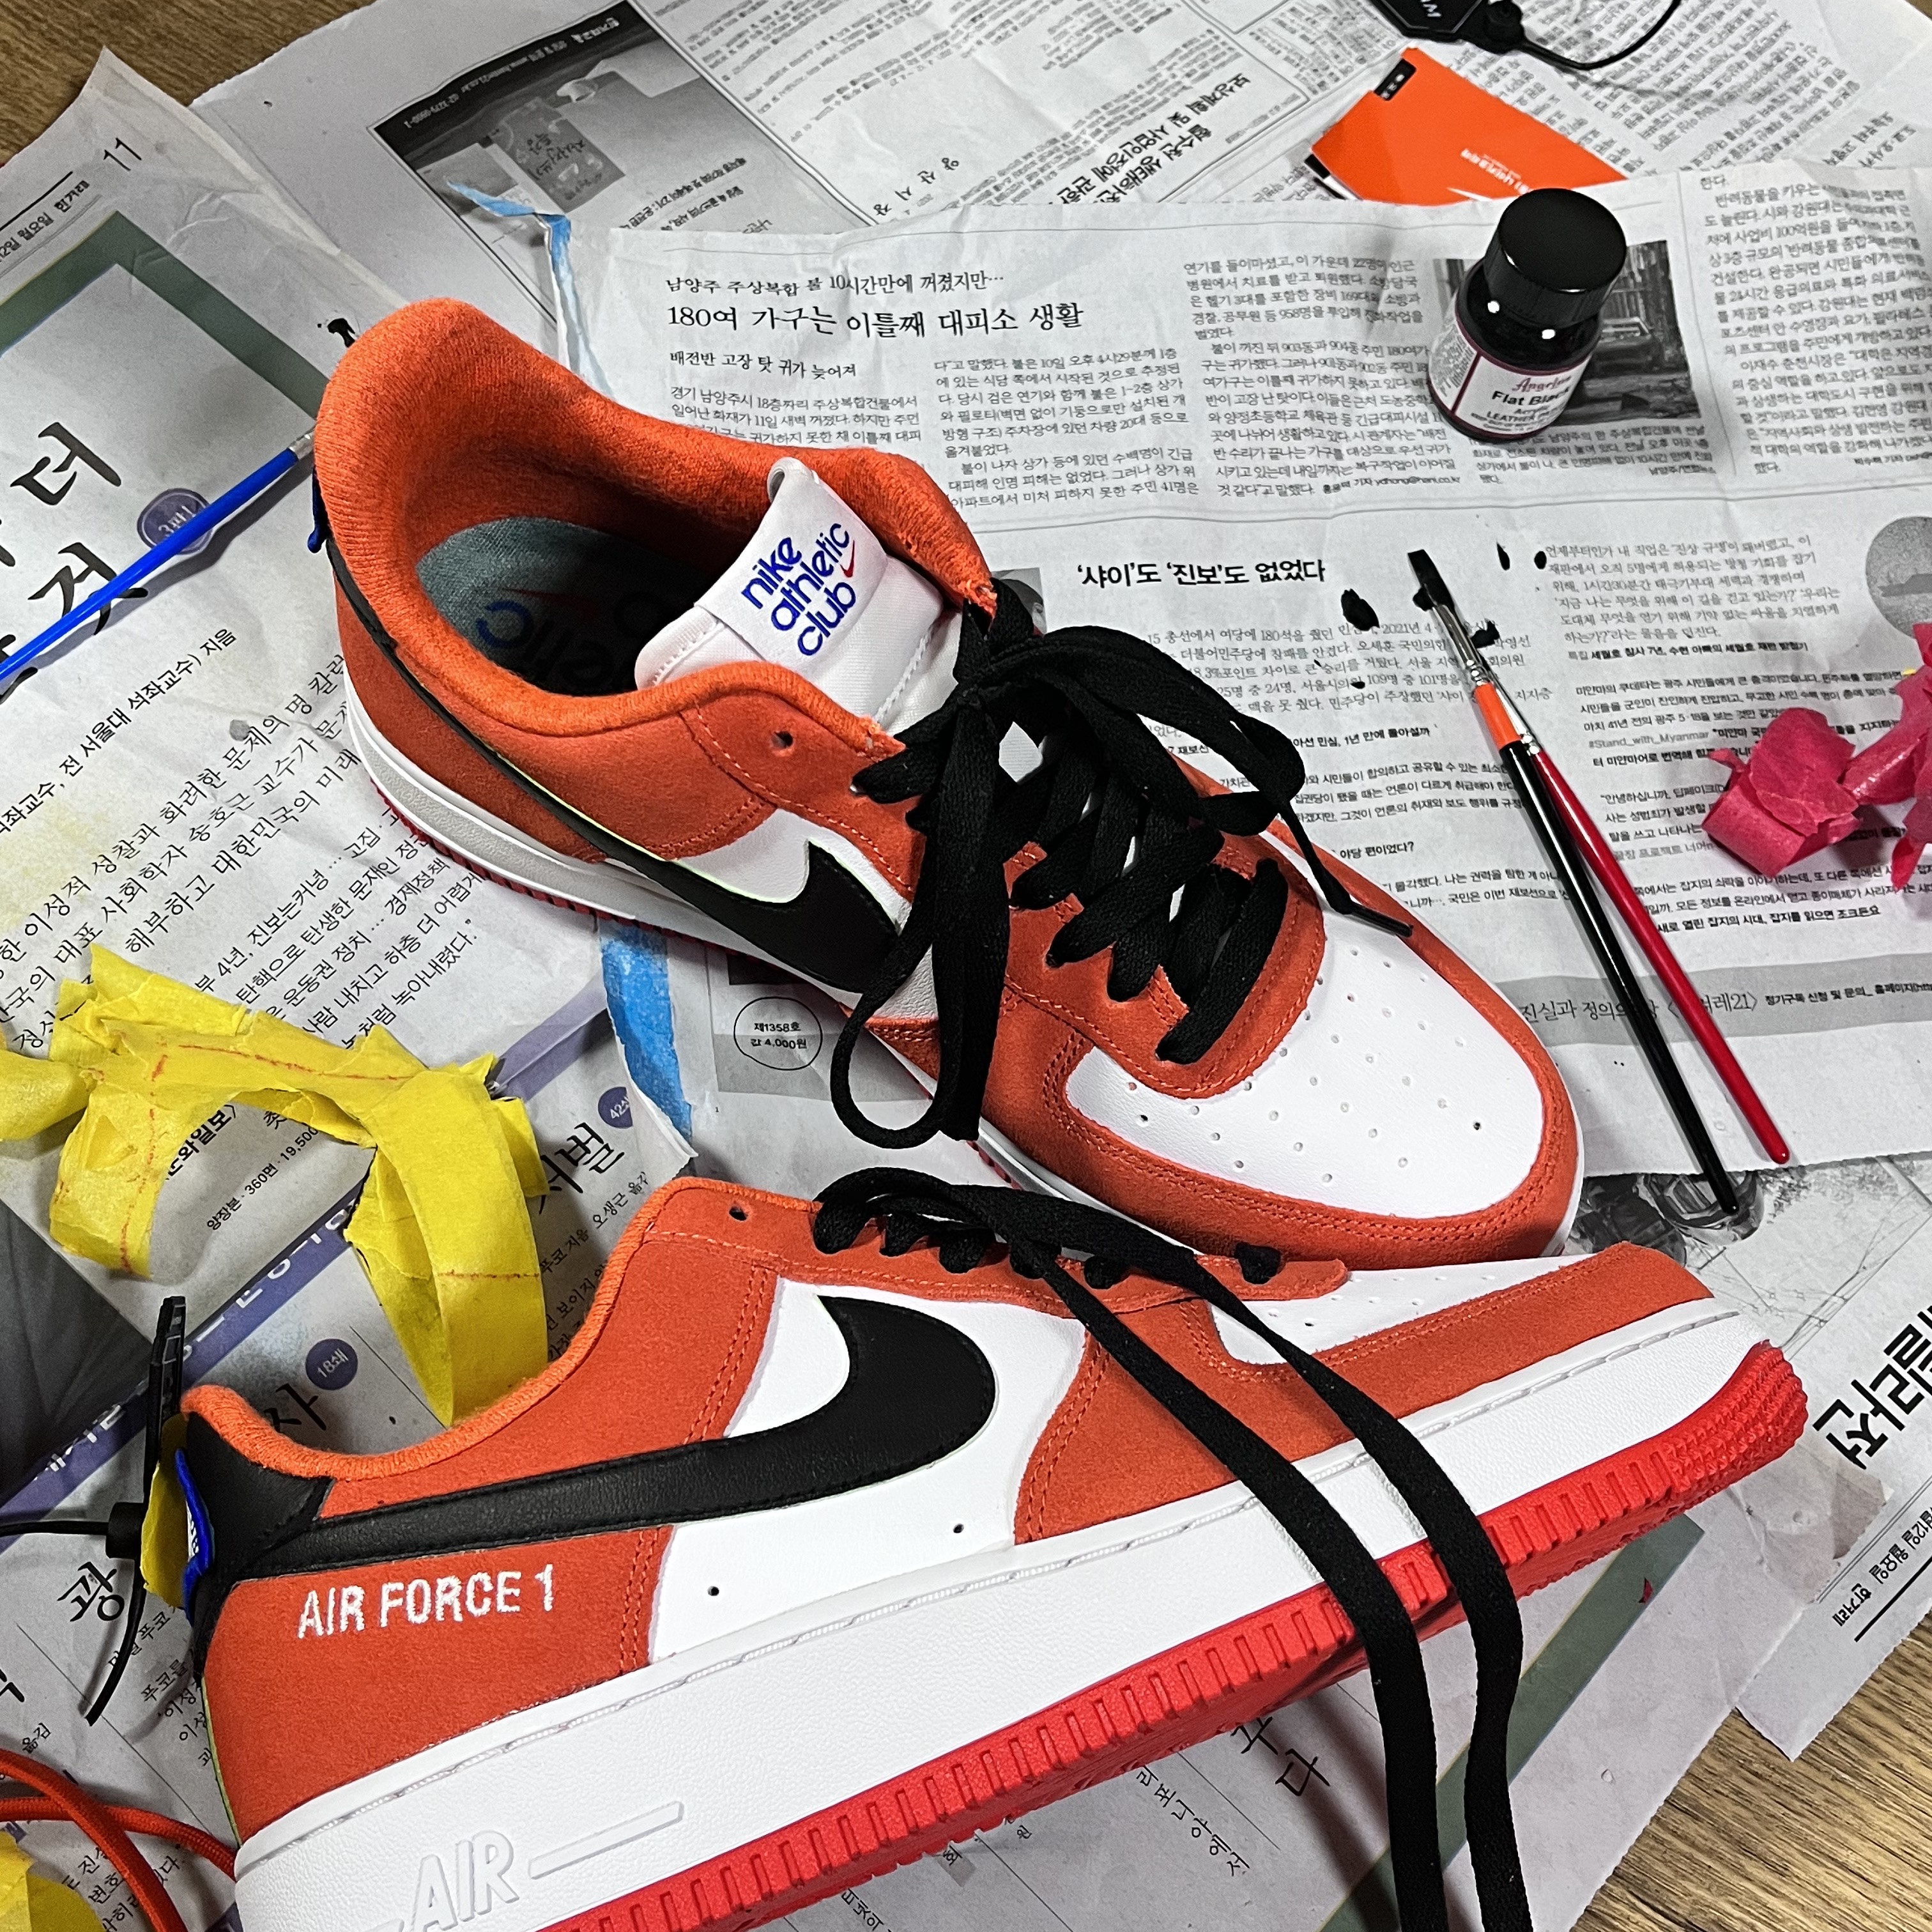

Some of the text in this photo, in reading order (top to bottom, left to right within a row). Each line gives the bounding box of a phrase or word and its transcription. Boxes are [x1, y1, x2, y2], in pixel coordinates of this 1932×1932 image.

[1185, 72, 1251, 115] 보상계획
[1168, 111, 1192, 128] 및
[103, 137, 142, 171] 11
[1091, 125, 1170, 182] 사업인정에
[17, 211, 55, 241] 월요일
[54, 180, 90, 213] 한겨레
[666, 277, 721, 294] 남양주
[727, 280, 801, 296] 주상복합
[829, 274, 913, 295] 10시간만에
[667, 302, 1084, 338] 180여 가구는 이틀째 대피소 생활
[670, 351, 857, 380] 배전반 고장 탓 귀가 늦어져
[953, 362, 1181, 388] 있는 시작된 추정된
[671, 385, 918, 411] 경기 남양주시 18층짜리 주상복합건물에서
[1016, 388, 1086, 403] 연기와 함께
[1059, 402, 1126, 418] 기둥으로만
[1492, 390, 1526, 406] Flat
[671, 404, 891, 429] 일어난 화재가 11일 새벽 하지만
[806, 431, 834, 443] 못한
[1229, 445, 1397, 461] 수리가 끝나는 대상으로
[1112, 465, 1151, 479] 그러나
[1254, 466, 1291, 479] 있는데
[1023, 485, 1126, 503] 미처 피하지 못한
[740, 537, 802, 610] nike
[770, 523, 850, 631] athletic
[1255, 559, 1326, 583] 없었다
[797, 582, 856, 656] club
[1165, 628, 1305, 645] 총선에서 여당에 180석을
[1181, 640, 1396, 662] 더불어민주당에 오세훈
[1262, 663, 1301, 677] 차이로
[1367, 673, 1398, 686] 109명
[59, 754, 84, 777] 전
[80, 707, 132, 758] 서울대
[127, 653, 201, 710] 석좌교수)
[199, 629, 237, 657] 지음
[1329, 691, 1379, 710] 민주당이
[1344, 729, 1385, 745] 1년 만에
[0, 938, 27, 981] 한
[24, 875, 92, 937] 이성적
[91, 823, 160, 876] 성찰과
[160, 768, 227, 825] 화려한
[222, 714, 290, 770] 문체의
[284, 693, 312, 715] 명
[54, 922, 103, 963] 대표
[100, 843, 188, 924] 사회학자
[189, 792, 255, 841] 송호근
[254, 737, 318, 795] 교수가
[125, 748, 363, 953] 해부하고 대한민국의 미래
[215, 868, 330, 978] 4년, 진보는커녕
[236, 855, 399, 1005] 탄핵으로 탄생한 문재인
[284, 857, 452, 1008] 운동권 정치 경제정책
[334, 963, 390, 1008] 내치고
[384, 933, 422, 966] 하층
[415, 912, 441, 935] 더
[1519, 995, 1577, 1022] 진실과
[753, 1022, 802, 1032] 제1358호
[764, 1038, 807, 1050] 4,000원
[206, 1196, 243, 1230] 양장본
[244, 1162, 279, 1195] 360면
[592, 1192, 629, 1230] 오생근
[317, 1348, 349, 1378] 18쇄
[1832, 1543, 1909, 1627] 월요일 한겨레
[296, 1563, 555, 1639] AIR FORCE 1
[141, 1659, 189, 1702] 푸코를
[21, 1722, 52, 1754] 옮김
[411, 1829, 521, 1932] AIR
